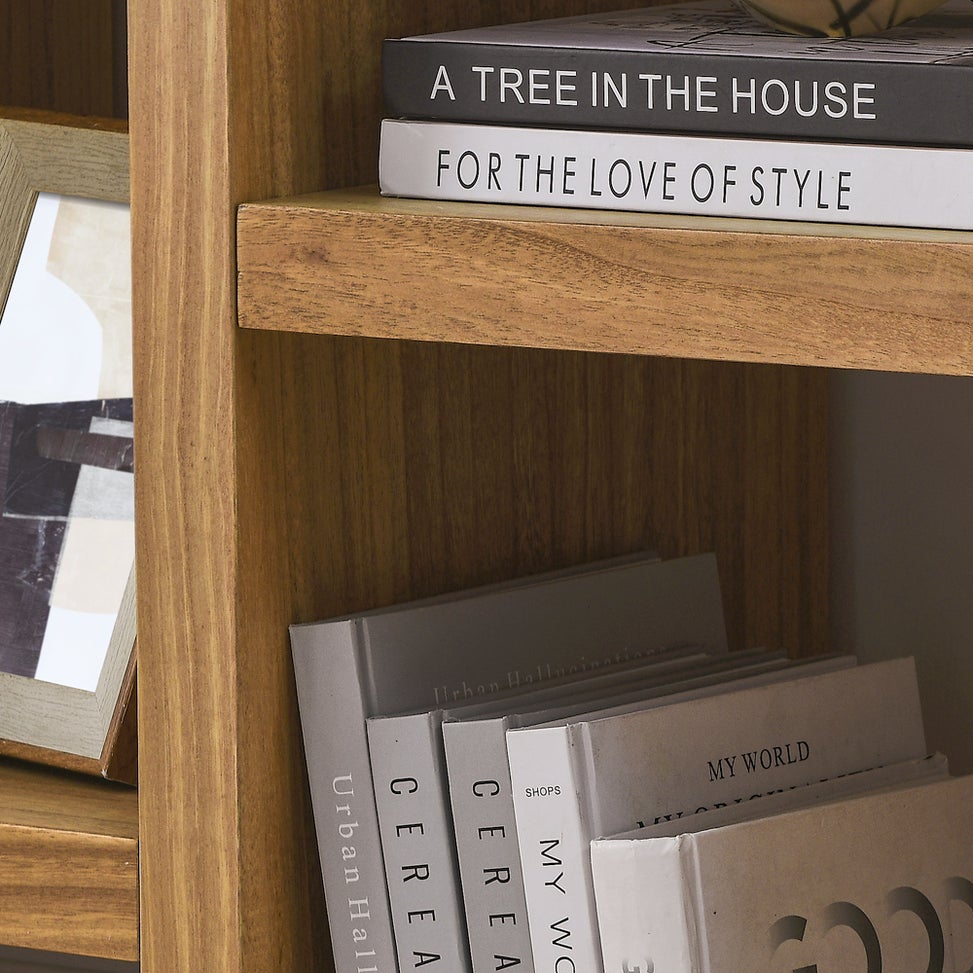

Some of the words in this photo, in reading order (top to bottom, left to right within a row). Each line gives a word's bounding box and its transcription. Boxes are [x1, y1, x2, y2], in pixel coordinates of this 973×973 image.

[430, 65, 456, 101] A
[472, 66, 578, 106] TREE
[592, 71, 627, 108] IN
[639, 74, 718, 112] THE
[732, 77, 876, 120] HOUSE
[437, 150, 502, 190] FOR
[515, 154, 576, 194] THE
[591, 158, 676, 200] LOVE
[691, 163, 736, 203] OF
[750, 166, 851, 210] STYLE
[707, 755, 738, 783] MY
[741, 740, 810, 774] WORLD
[525, 785, 561, 798] SHOPS
[332, 772, 360, 884] Urban
[539, 839, 566, 895] MY
